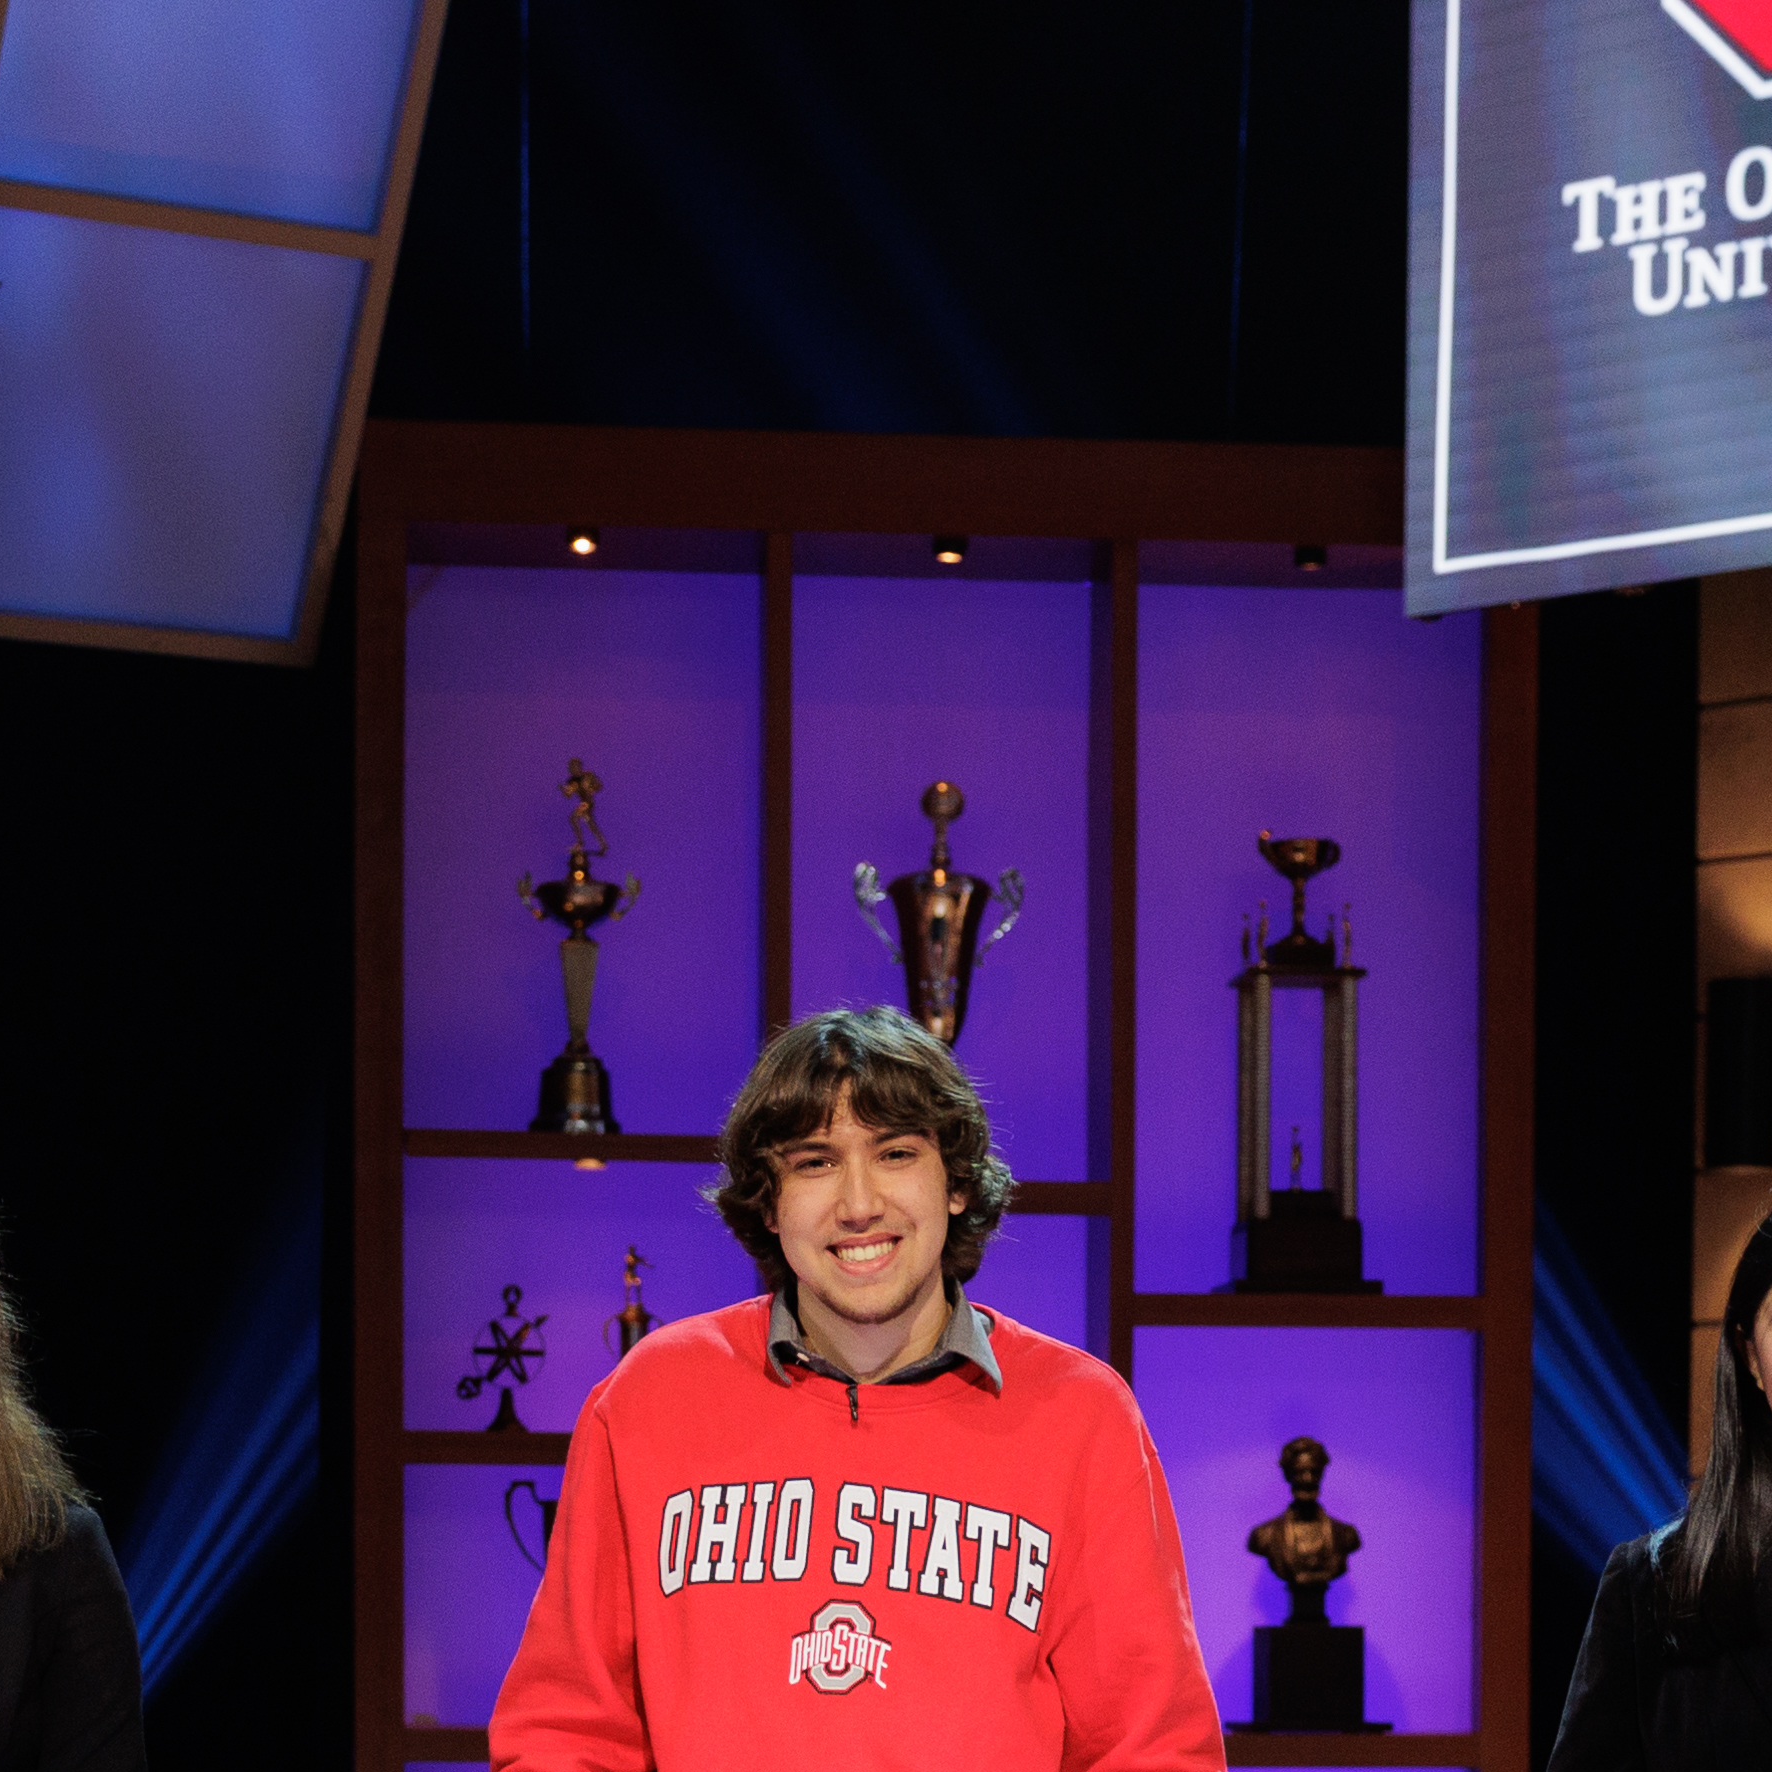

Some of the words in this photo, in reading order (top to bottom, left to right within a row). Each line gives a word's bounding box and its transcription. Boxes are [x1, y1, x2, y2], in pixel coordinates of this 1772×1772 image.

[1562, 172, 1706, 252] THE
[658, 1477, 814, 1597] OHIO
[831, 1481, 1051, 1633] STATE
